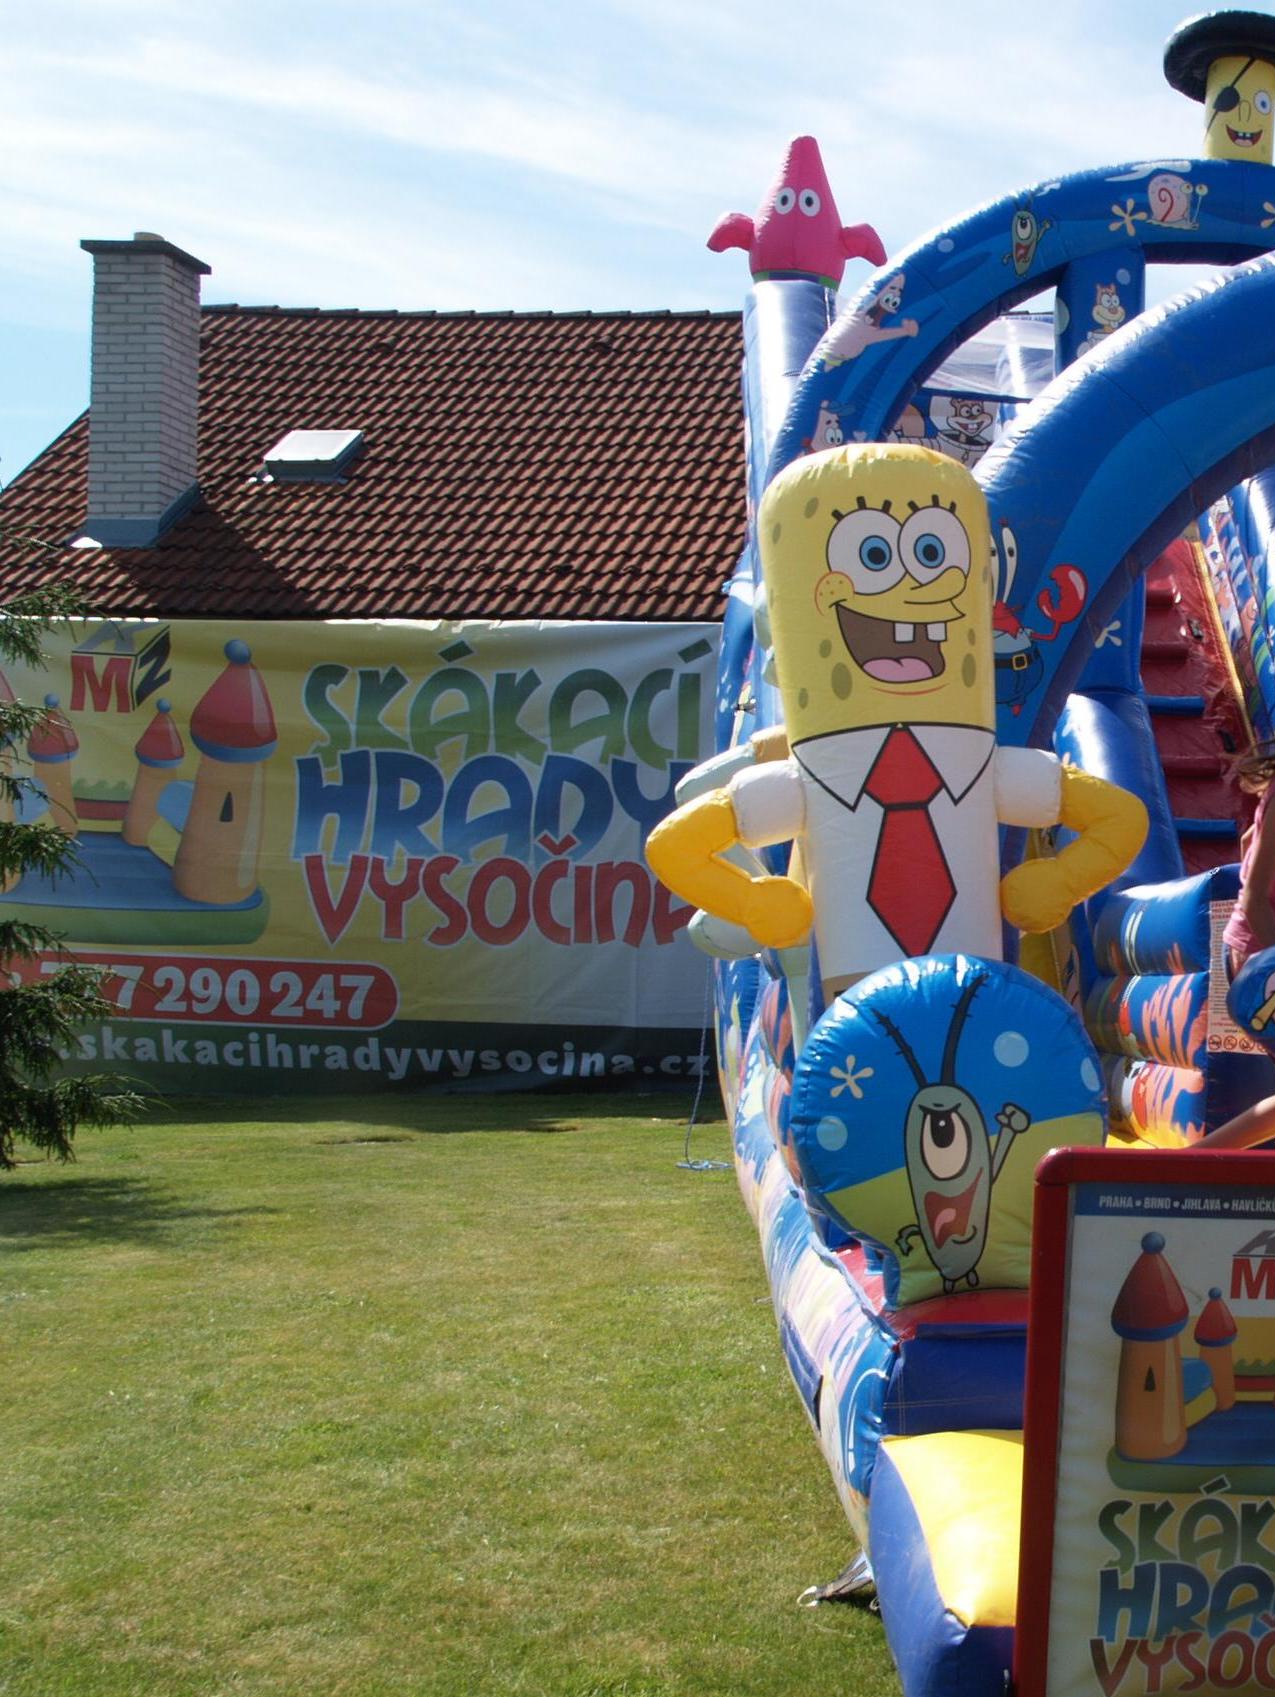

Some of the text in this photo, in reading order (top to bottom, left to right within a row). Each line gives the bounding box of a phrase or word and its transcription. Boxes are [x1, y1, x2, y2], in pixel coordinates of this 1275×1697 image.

[306, 640, 712, 770] SKÁKACÍ
[294, 750, 696, 864] HRADY
[155, 966, 260, 1015] 290
[278, 974, 375, 1020] 247
[58, 1026, 710, 1078] .skakacihradyvysocina.cz
[1099, 1196, 1134, 1209] PRAHA
[1143, 1197, 1171, 1209] BRNO
[1181, 1198, 1221, 1211] JIHLAVA
